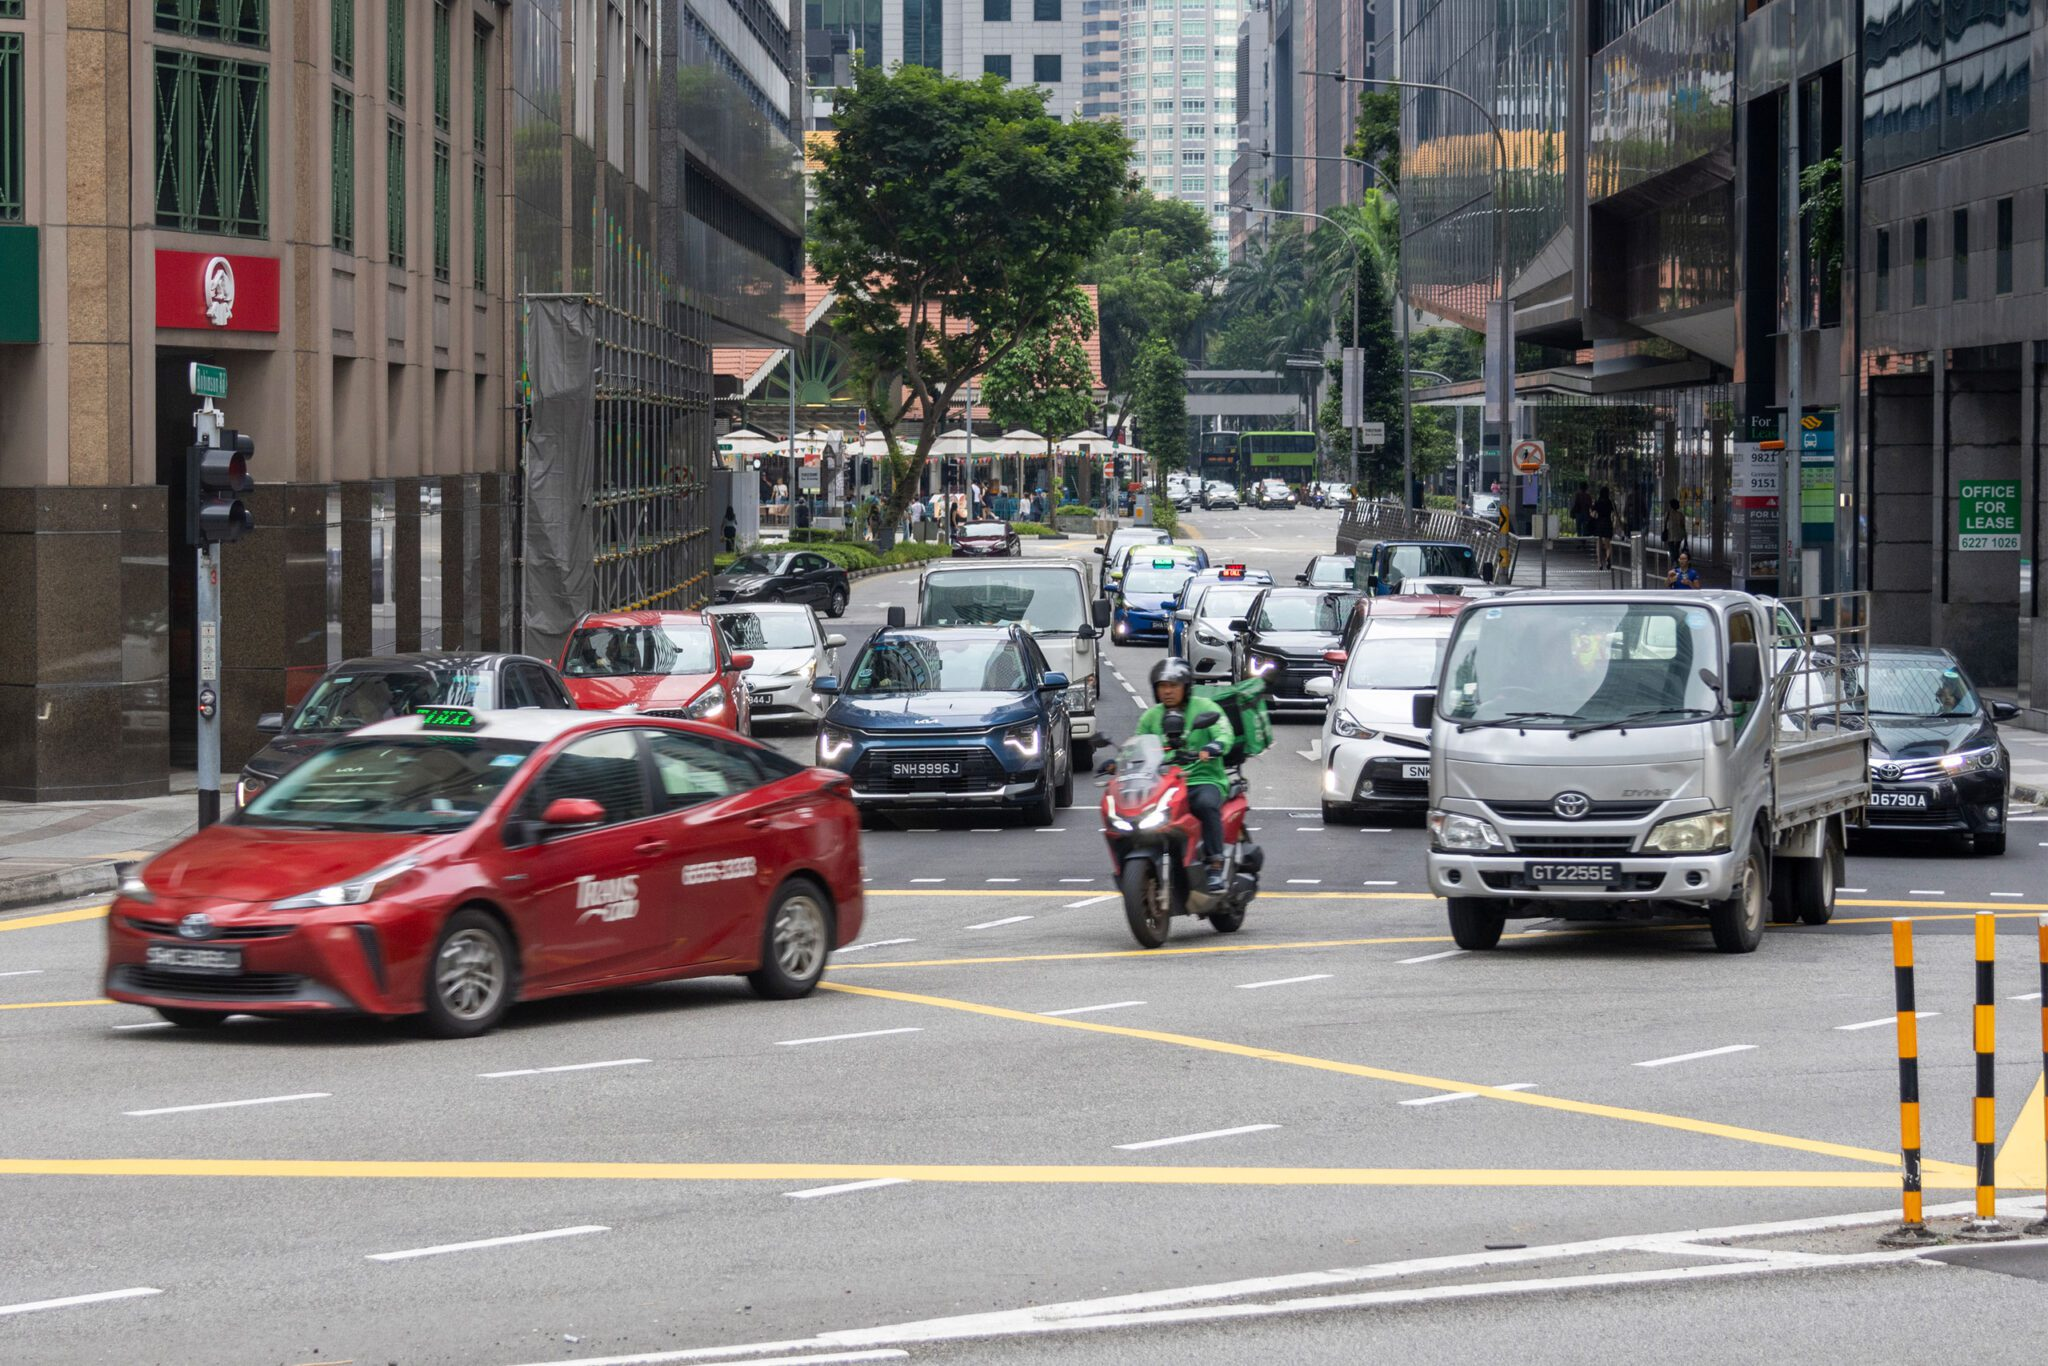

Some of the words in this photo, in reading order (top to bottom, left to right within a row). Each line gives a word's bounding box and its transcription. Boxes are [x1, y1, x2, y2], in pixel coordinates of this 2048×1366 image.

[1751, 415, 1771, 427] For
[1751, 452, 1776, 463] 9821
[1751, 478, 1777, 489] 9151
[1962, 486, 2015, 498] OFFICE
[1974, 501, 2006, 514] FOR
[1965, 517, 2015, 529] LEASE
[1961, 537, 1988, 549] 6227
[1991, 537, 2018, 549] 1026
